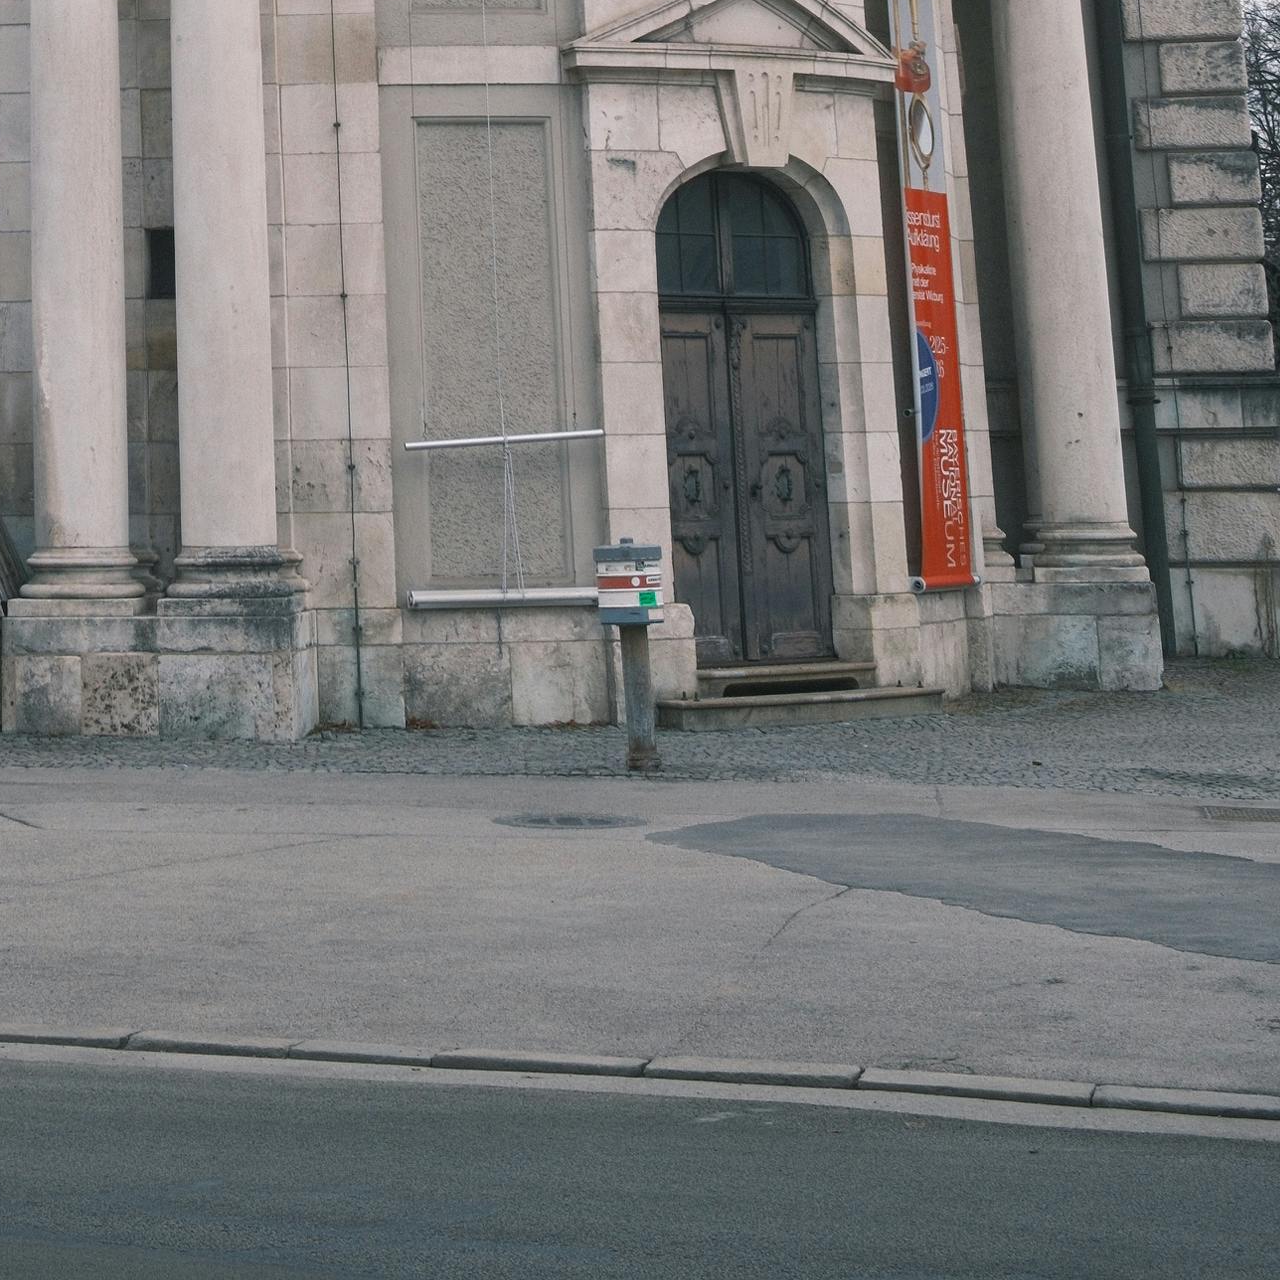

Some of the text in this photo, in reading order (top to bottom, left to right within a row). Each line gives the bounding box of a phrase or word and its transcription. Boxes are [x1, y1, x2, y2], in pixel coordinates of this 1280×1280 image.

[939, 429, 956, 568] MUSEUM
[946, 429, 960, 523] NATIONAL
[951, 429, 967, 567] BAYERISCHES
